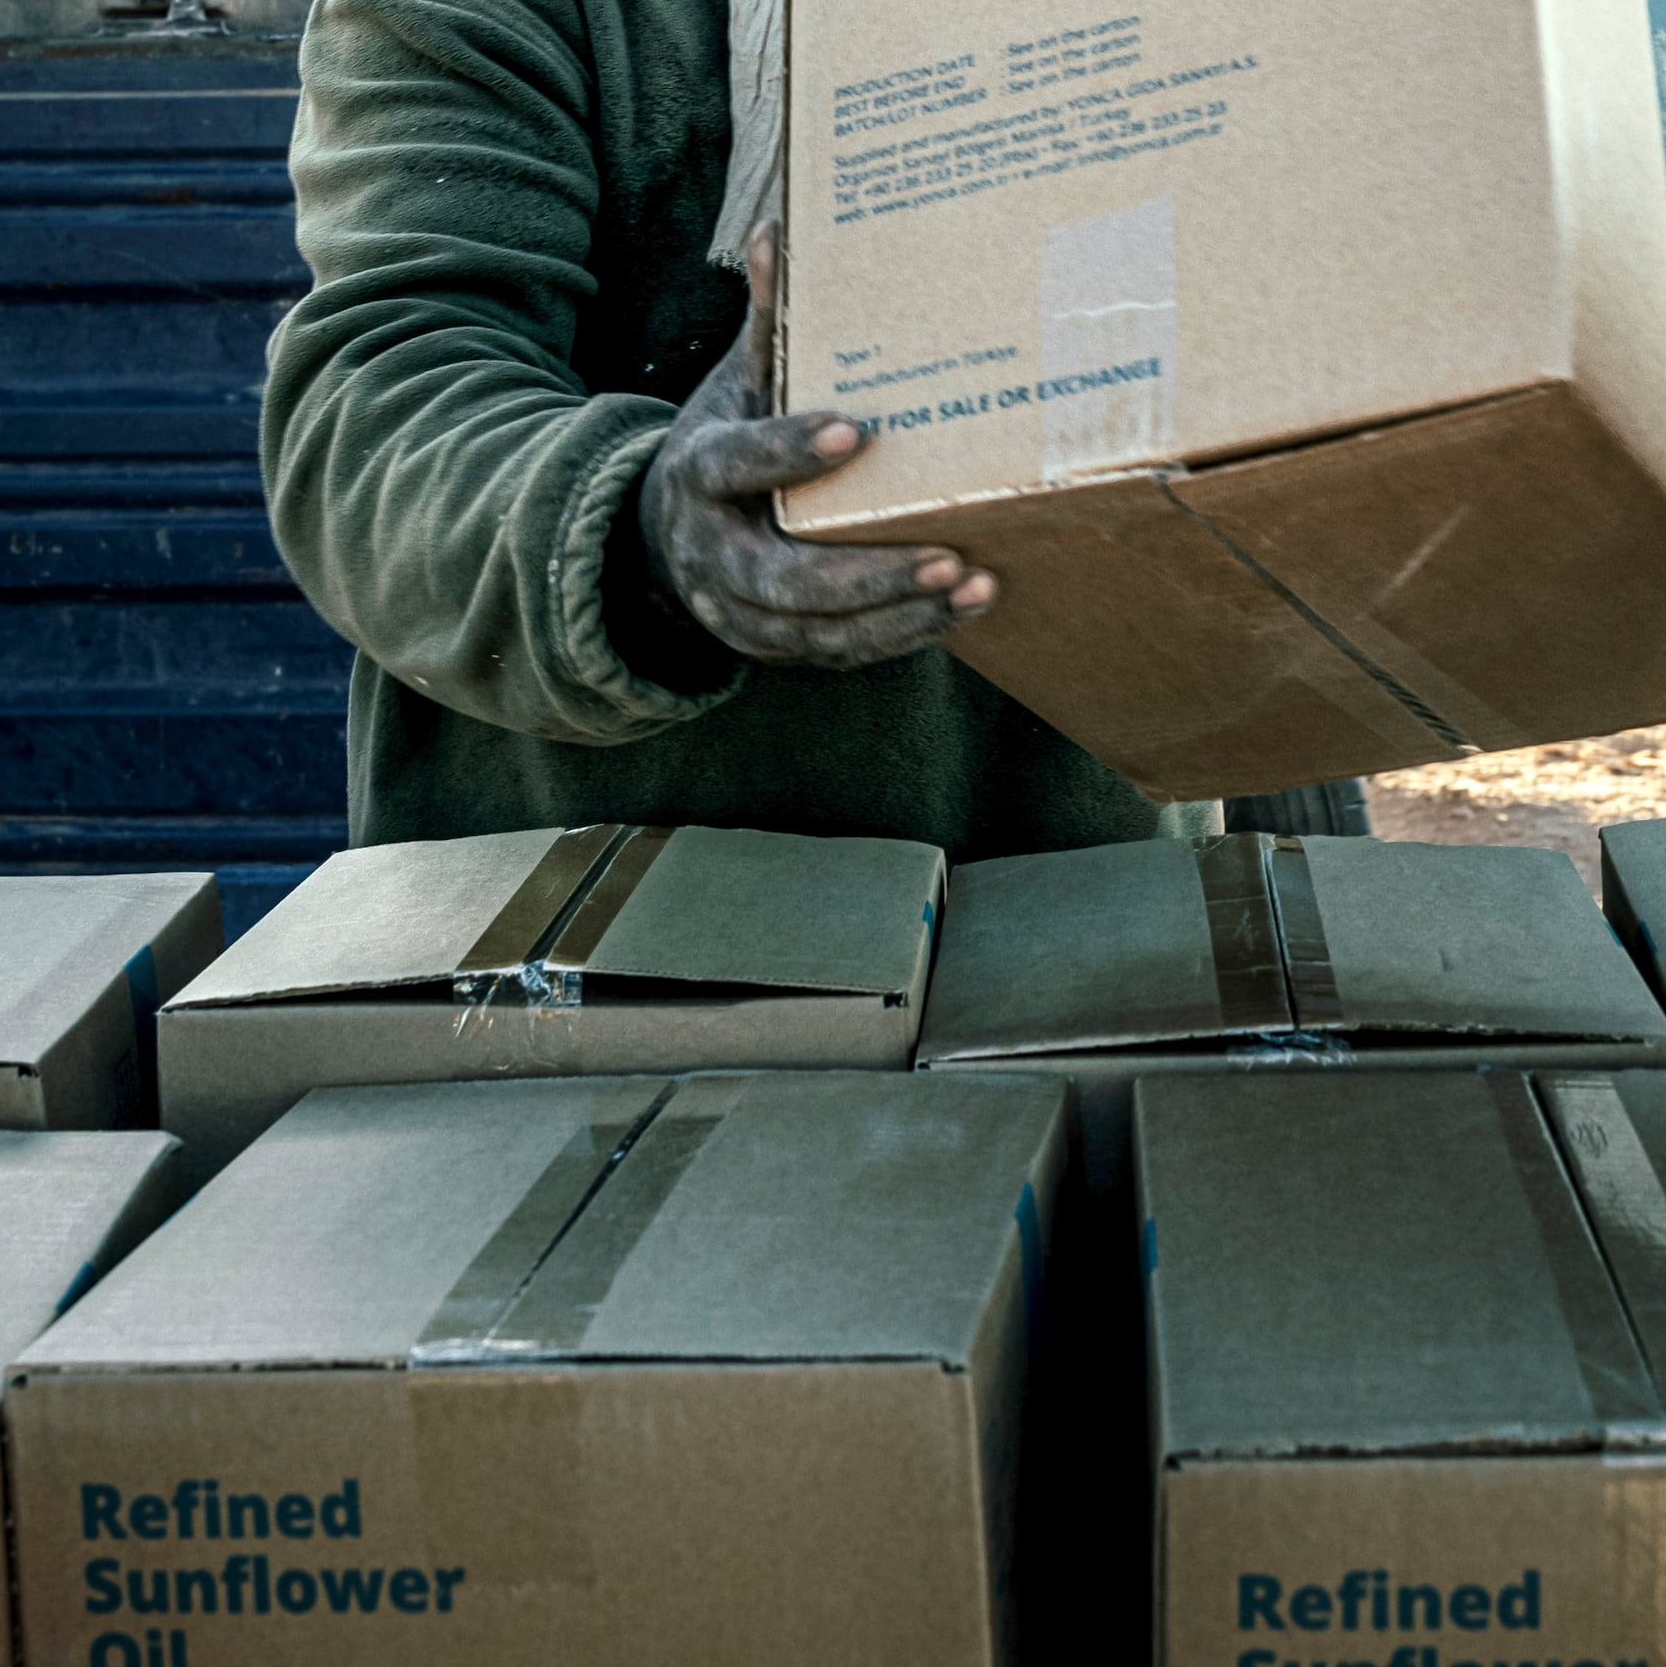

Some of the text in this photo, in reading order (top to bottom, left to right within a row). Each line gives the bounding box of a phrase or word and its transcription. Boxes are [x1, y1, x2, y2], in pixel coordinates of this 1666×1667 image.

[835, 53, 975, 99] PRODUCTION DATE
[835, 99, 868, 119] BEST
[873, 84, 929, 109] BEFORE
[921, 87, 988, 115] NUMBER
[888, 406, 932, 432] FOR
[938, 393, 991, 422] SALE
[997, 385, 1031, 410] OR
[1036, 356, 1161, 401] EXCHANGE
[80, 1477, 363, 1540] Refined
[83, 1554, 465, 1615] Sunflower
[1237, 1567, 1542, 1632] Refined
